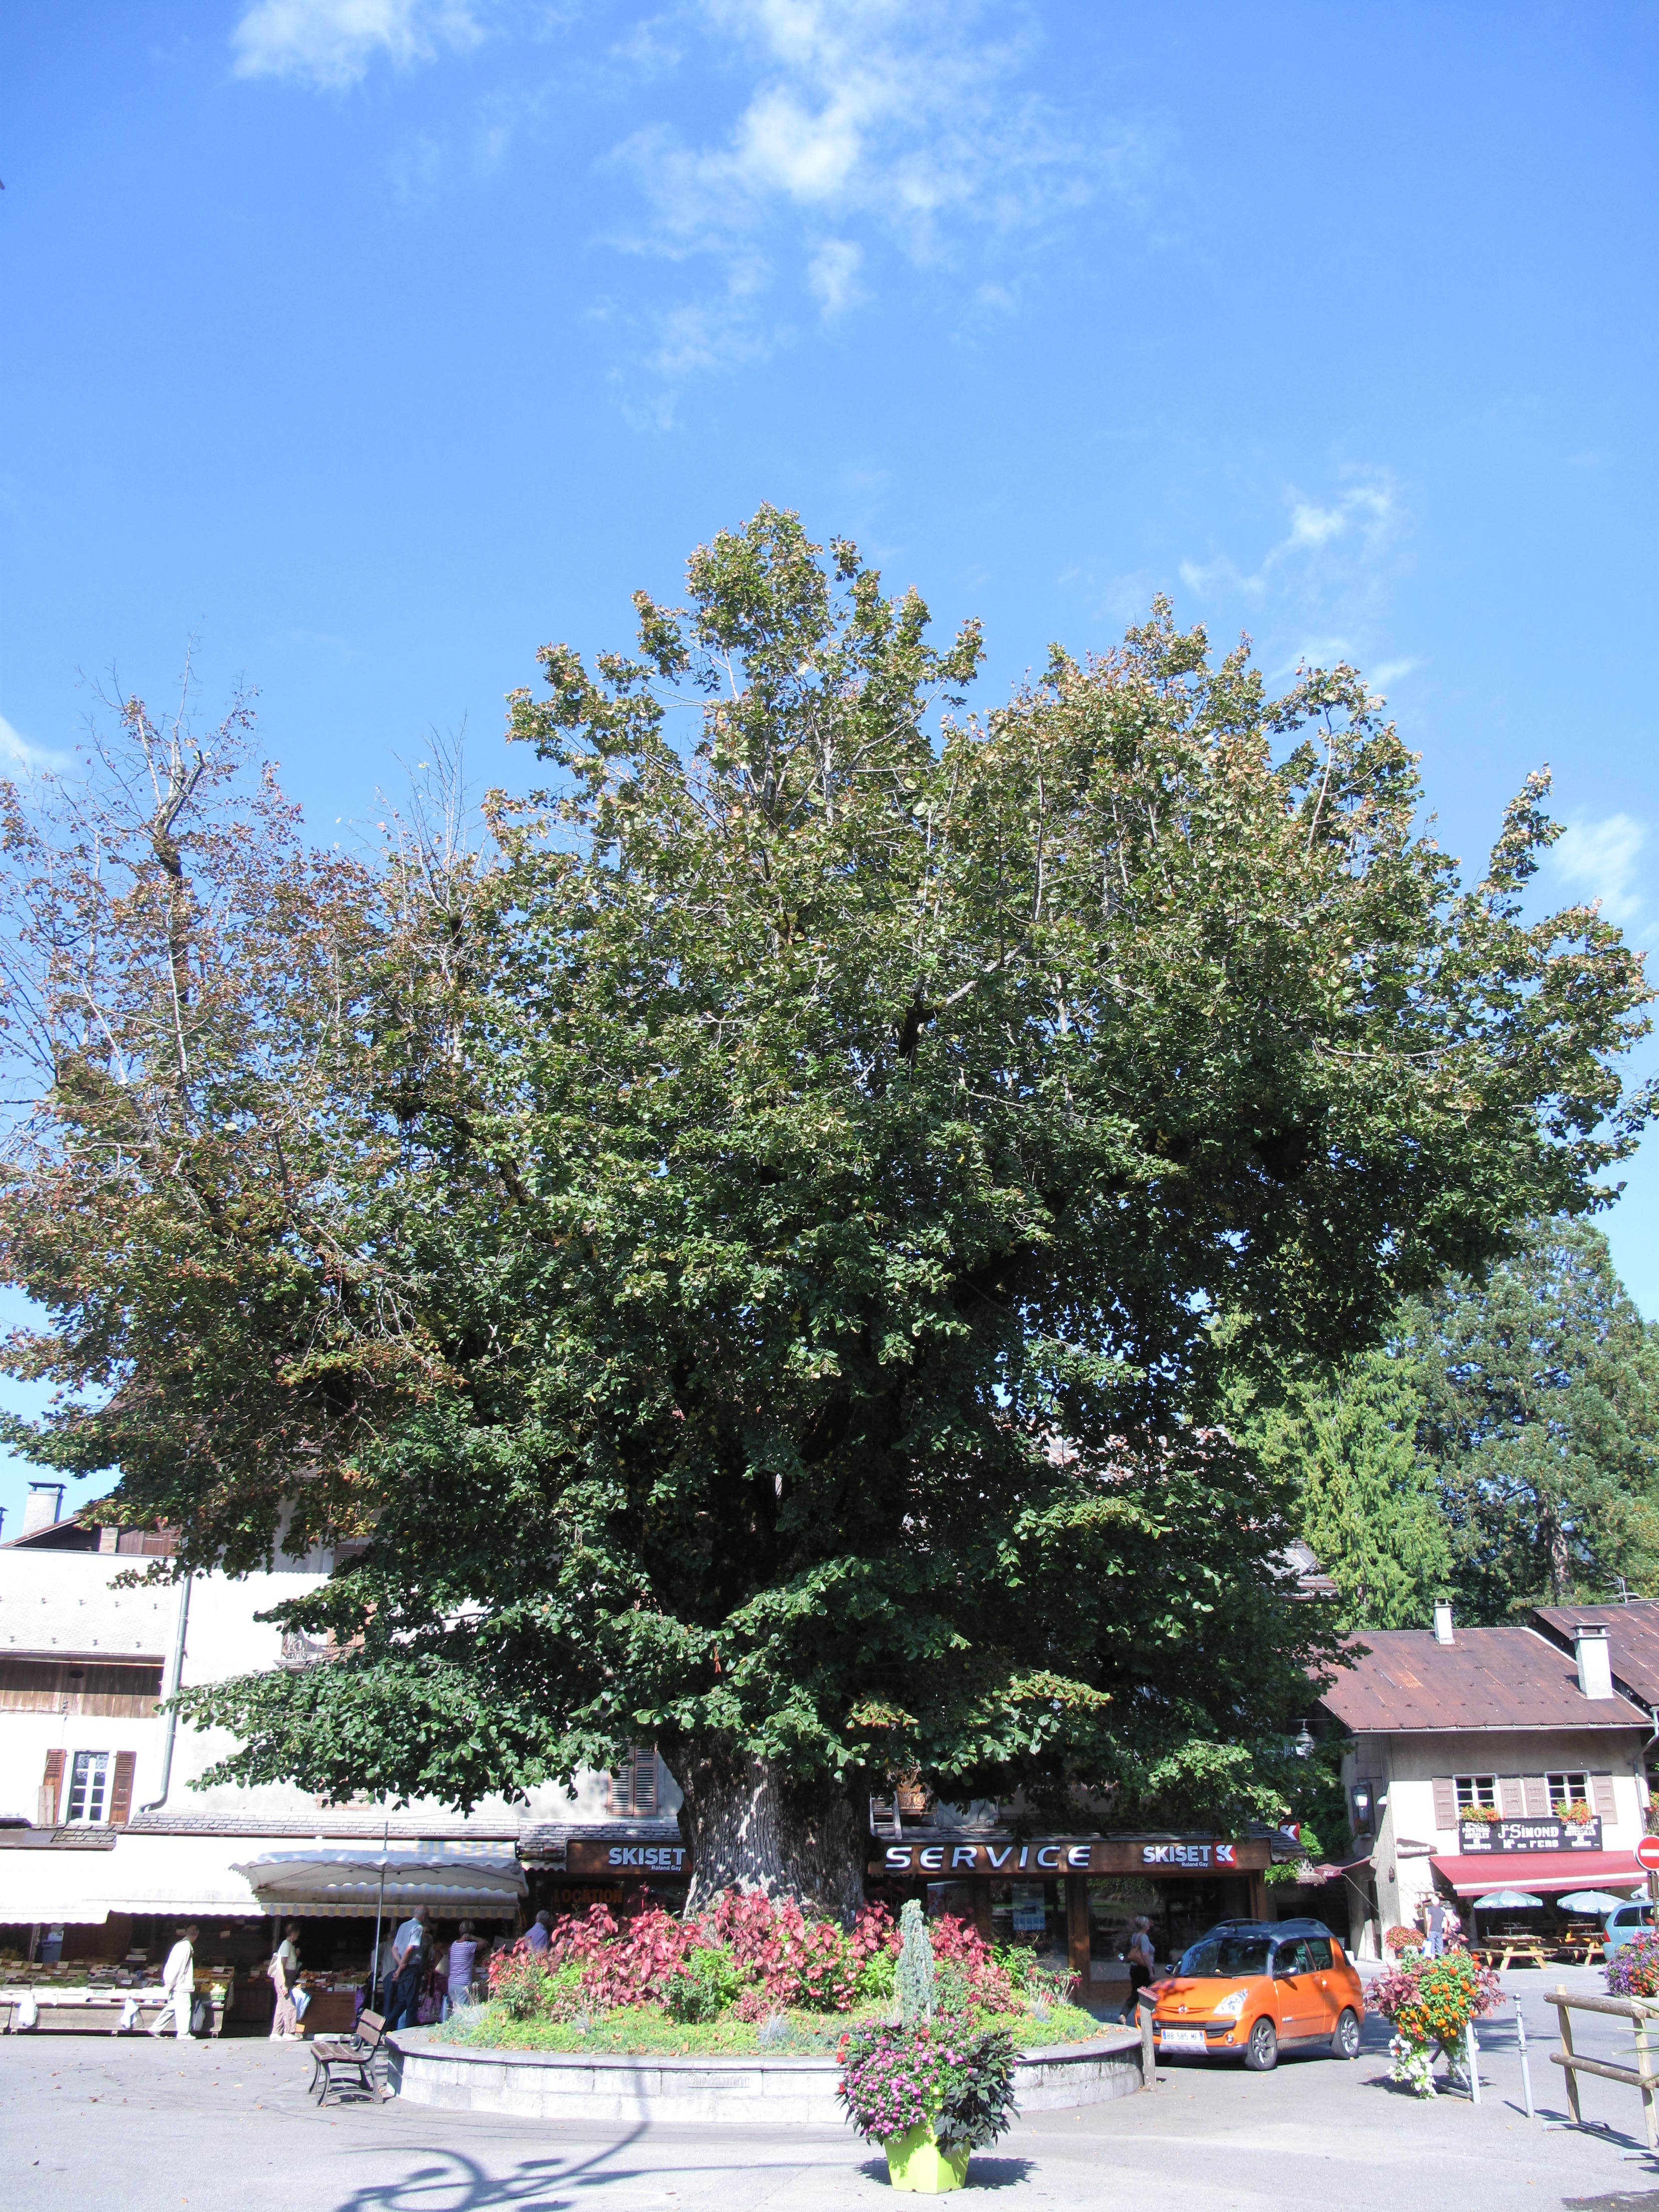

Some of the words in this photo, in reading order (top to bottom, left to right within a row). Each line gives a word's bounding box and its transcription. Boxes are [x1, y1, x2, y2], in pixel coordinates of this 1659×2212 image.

[609, 1847, 686, 1865] SKISET
[886, 1845, 1091, 1868] SERVICE
[1143, 1845, 1211, 1862] SKISET
[554, 1888, 623, 1904] LOCATION
